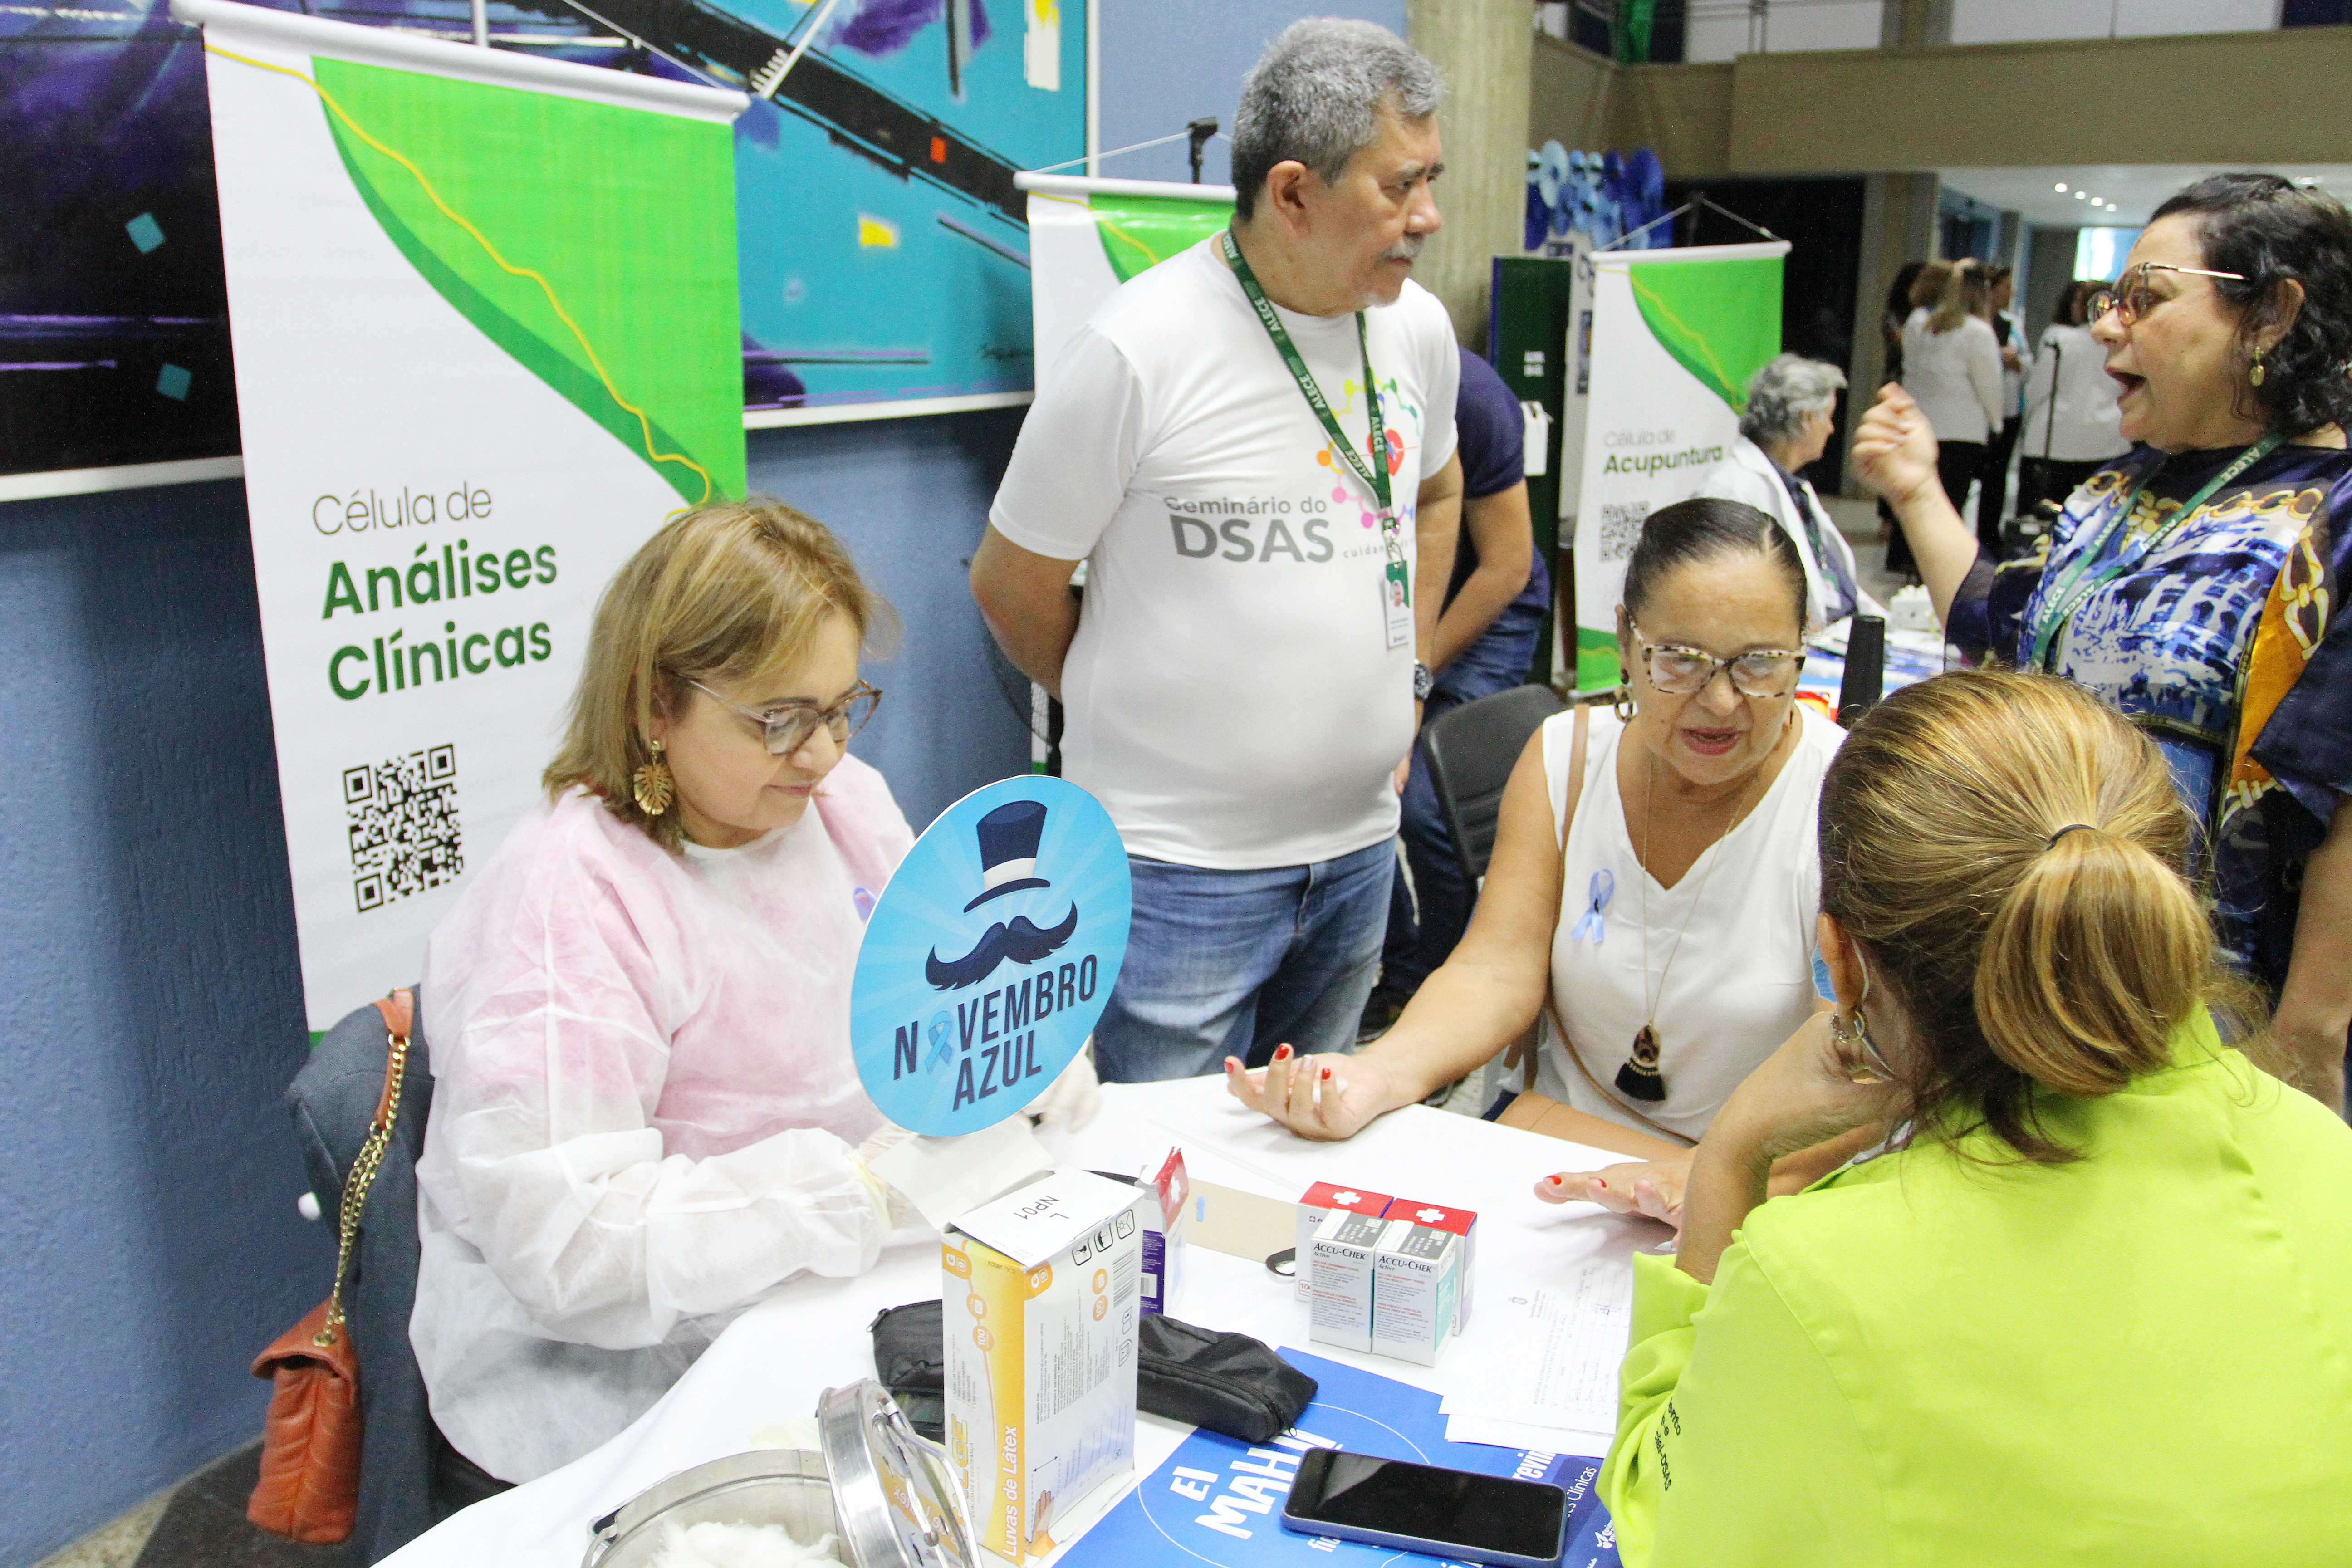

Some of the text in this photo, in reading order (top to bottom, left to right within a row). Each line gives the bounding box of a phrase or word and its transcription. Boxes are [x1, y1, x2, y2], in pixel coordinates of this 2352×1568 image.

[1604, 445, 1723, 478] Acupuntura
[2220, 447, 2260, 481] ALECE
[313, 481, 492, 536] Célula de
[1300, 496, 1327, 513] do
[1170, 514, 1334, 563] DSAS
[322, 538, 557, 620] Análises
[328, 620, 552, 702] Clínicas
[953, 1030, 1042, 1112] AZUL
[1013, 1195, 1060, 1220] NP01
[1313, 1243, 1366, 1260] ACCU-CHEK
[1378, 1255, 1433, 1273] ACCU-CHEK
[977, 1330, 987, 1347] 100
[1002, 1425, 1018, 1558] Luvas de Látex
[1170, 1466, 1219, 1502] EI
[1567, 1466, 1597, 1502] Clínicas
